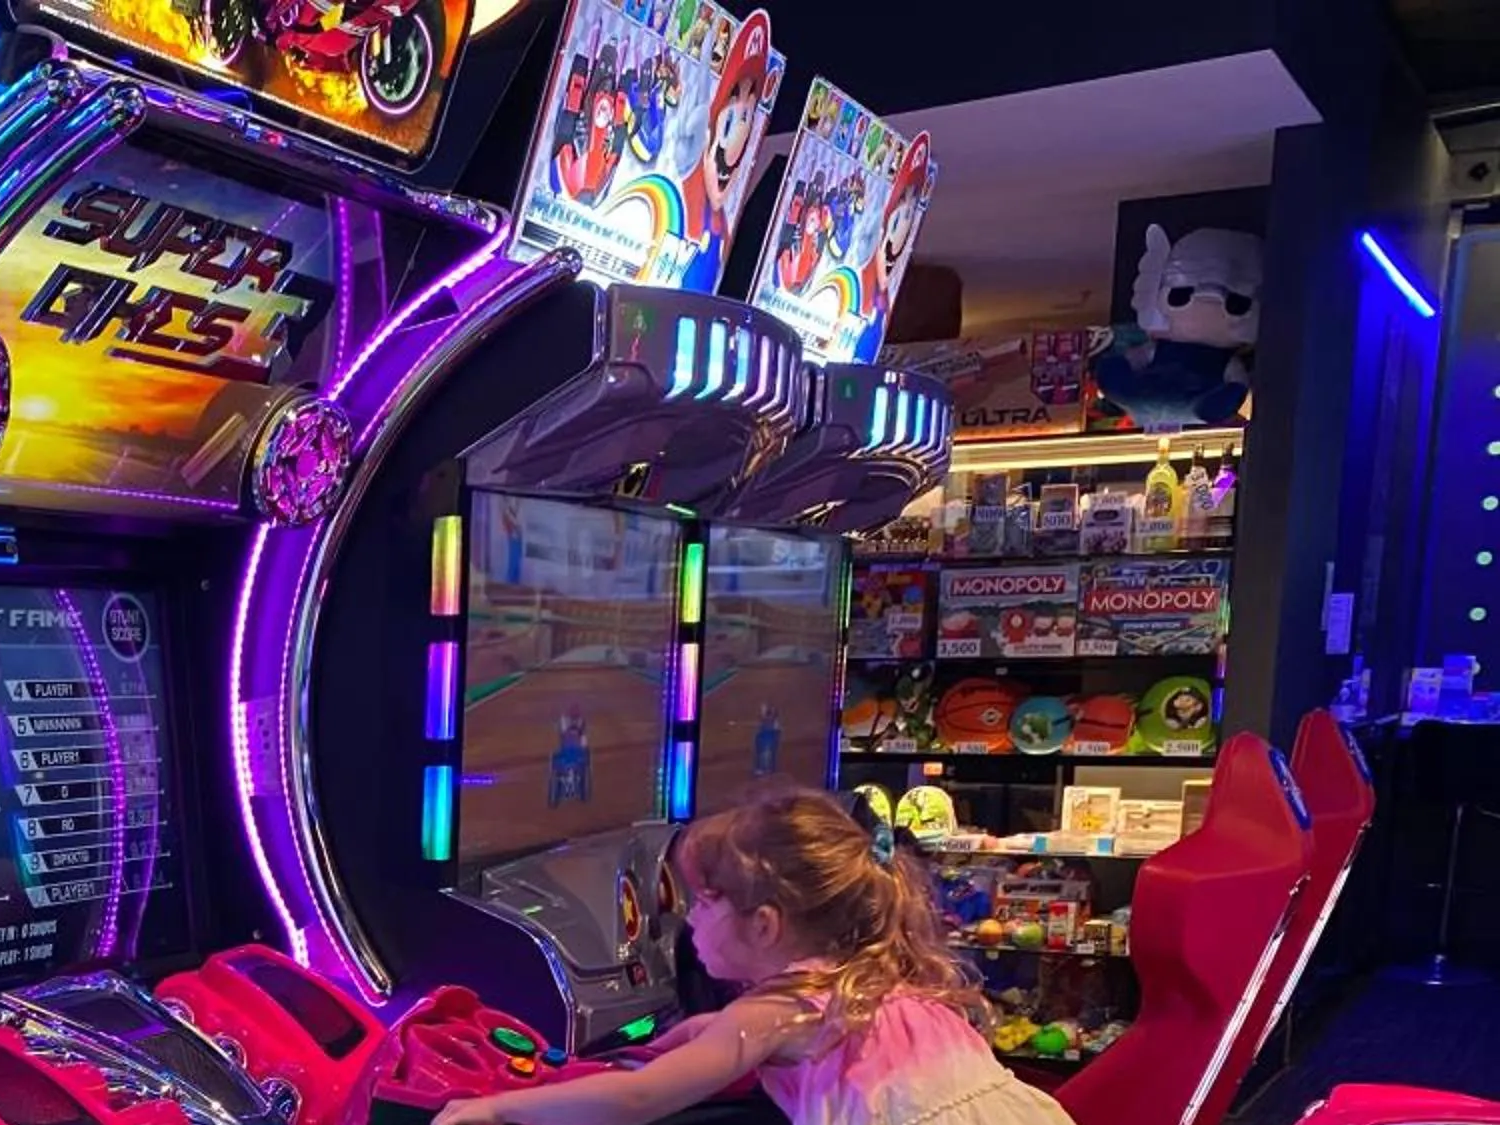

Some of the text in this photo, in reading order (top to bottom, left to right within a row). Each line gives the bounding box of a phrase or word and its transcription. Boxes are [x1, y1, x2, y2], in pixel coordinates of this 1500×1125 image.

[42, 182, 292, 293] SUPER
[961, 406, 1051, 427] ULTRA
[952, 575, 1065, 595] MONOPOLY
[1090, 591, 1216, 612] MONOPOLY
[34, 684, 73, 697] PLAYER1
[18, 717, 27, 734] 5
[41, 752, 80, 765] PLAYER1
[23, 786, 33, 801] 7
[28, 819, 37, 834] 8
[30, 852, 40, 868] 9
[51, 883, 95, 900] PLAYER1
